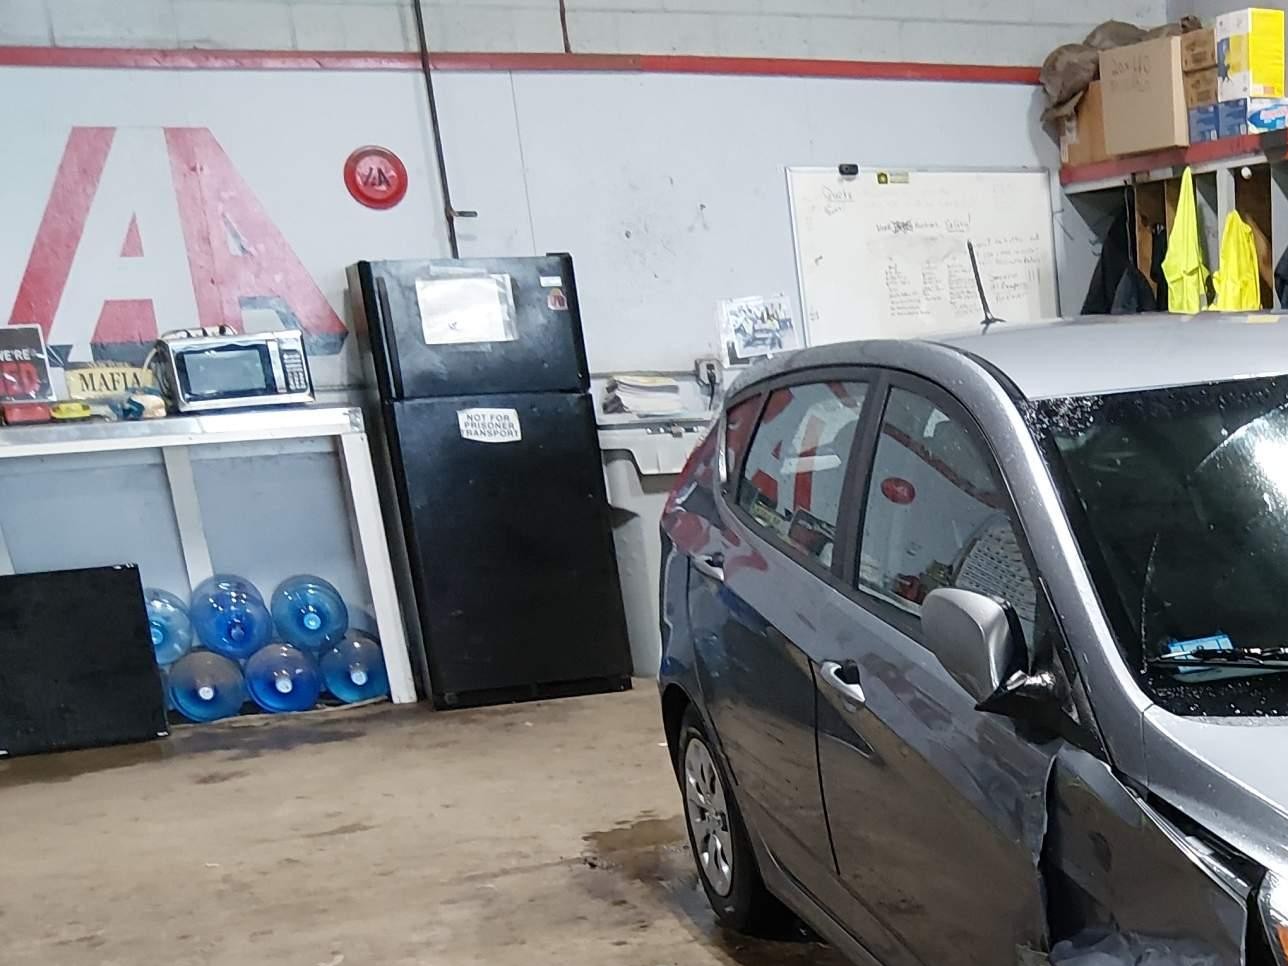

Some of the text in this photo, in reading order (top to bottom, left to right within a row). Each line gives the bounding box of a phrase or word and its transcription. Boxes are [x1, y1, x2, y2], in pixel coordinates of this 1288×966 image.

[80, 372, 141, 392] MAFIA
[466, 414, 511, 422] NOT FOR
[464, 421, 515, 430] PRISONER
